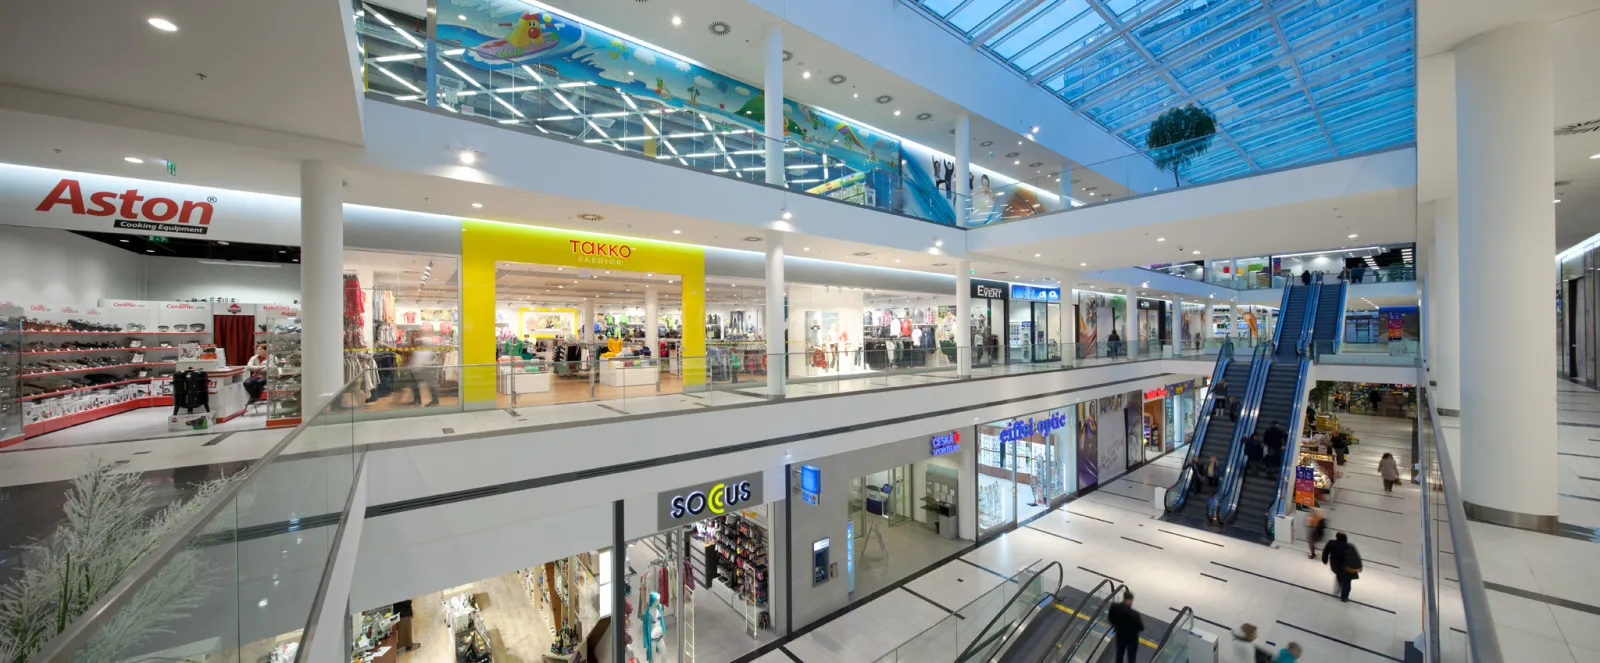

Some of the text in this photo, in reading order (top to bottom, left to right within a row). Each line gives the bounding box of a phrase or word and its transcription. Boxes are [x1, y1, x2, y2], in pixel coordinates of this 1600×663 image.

[120, 221, 203, 233] Cooking Equipment
[1000, 411, 1066, 443] eiffel optic
